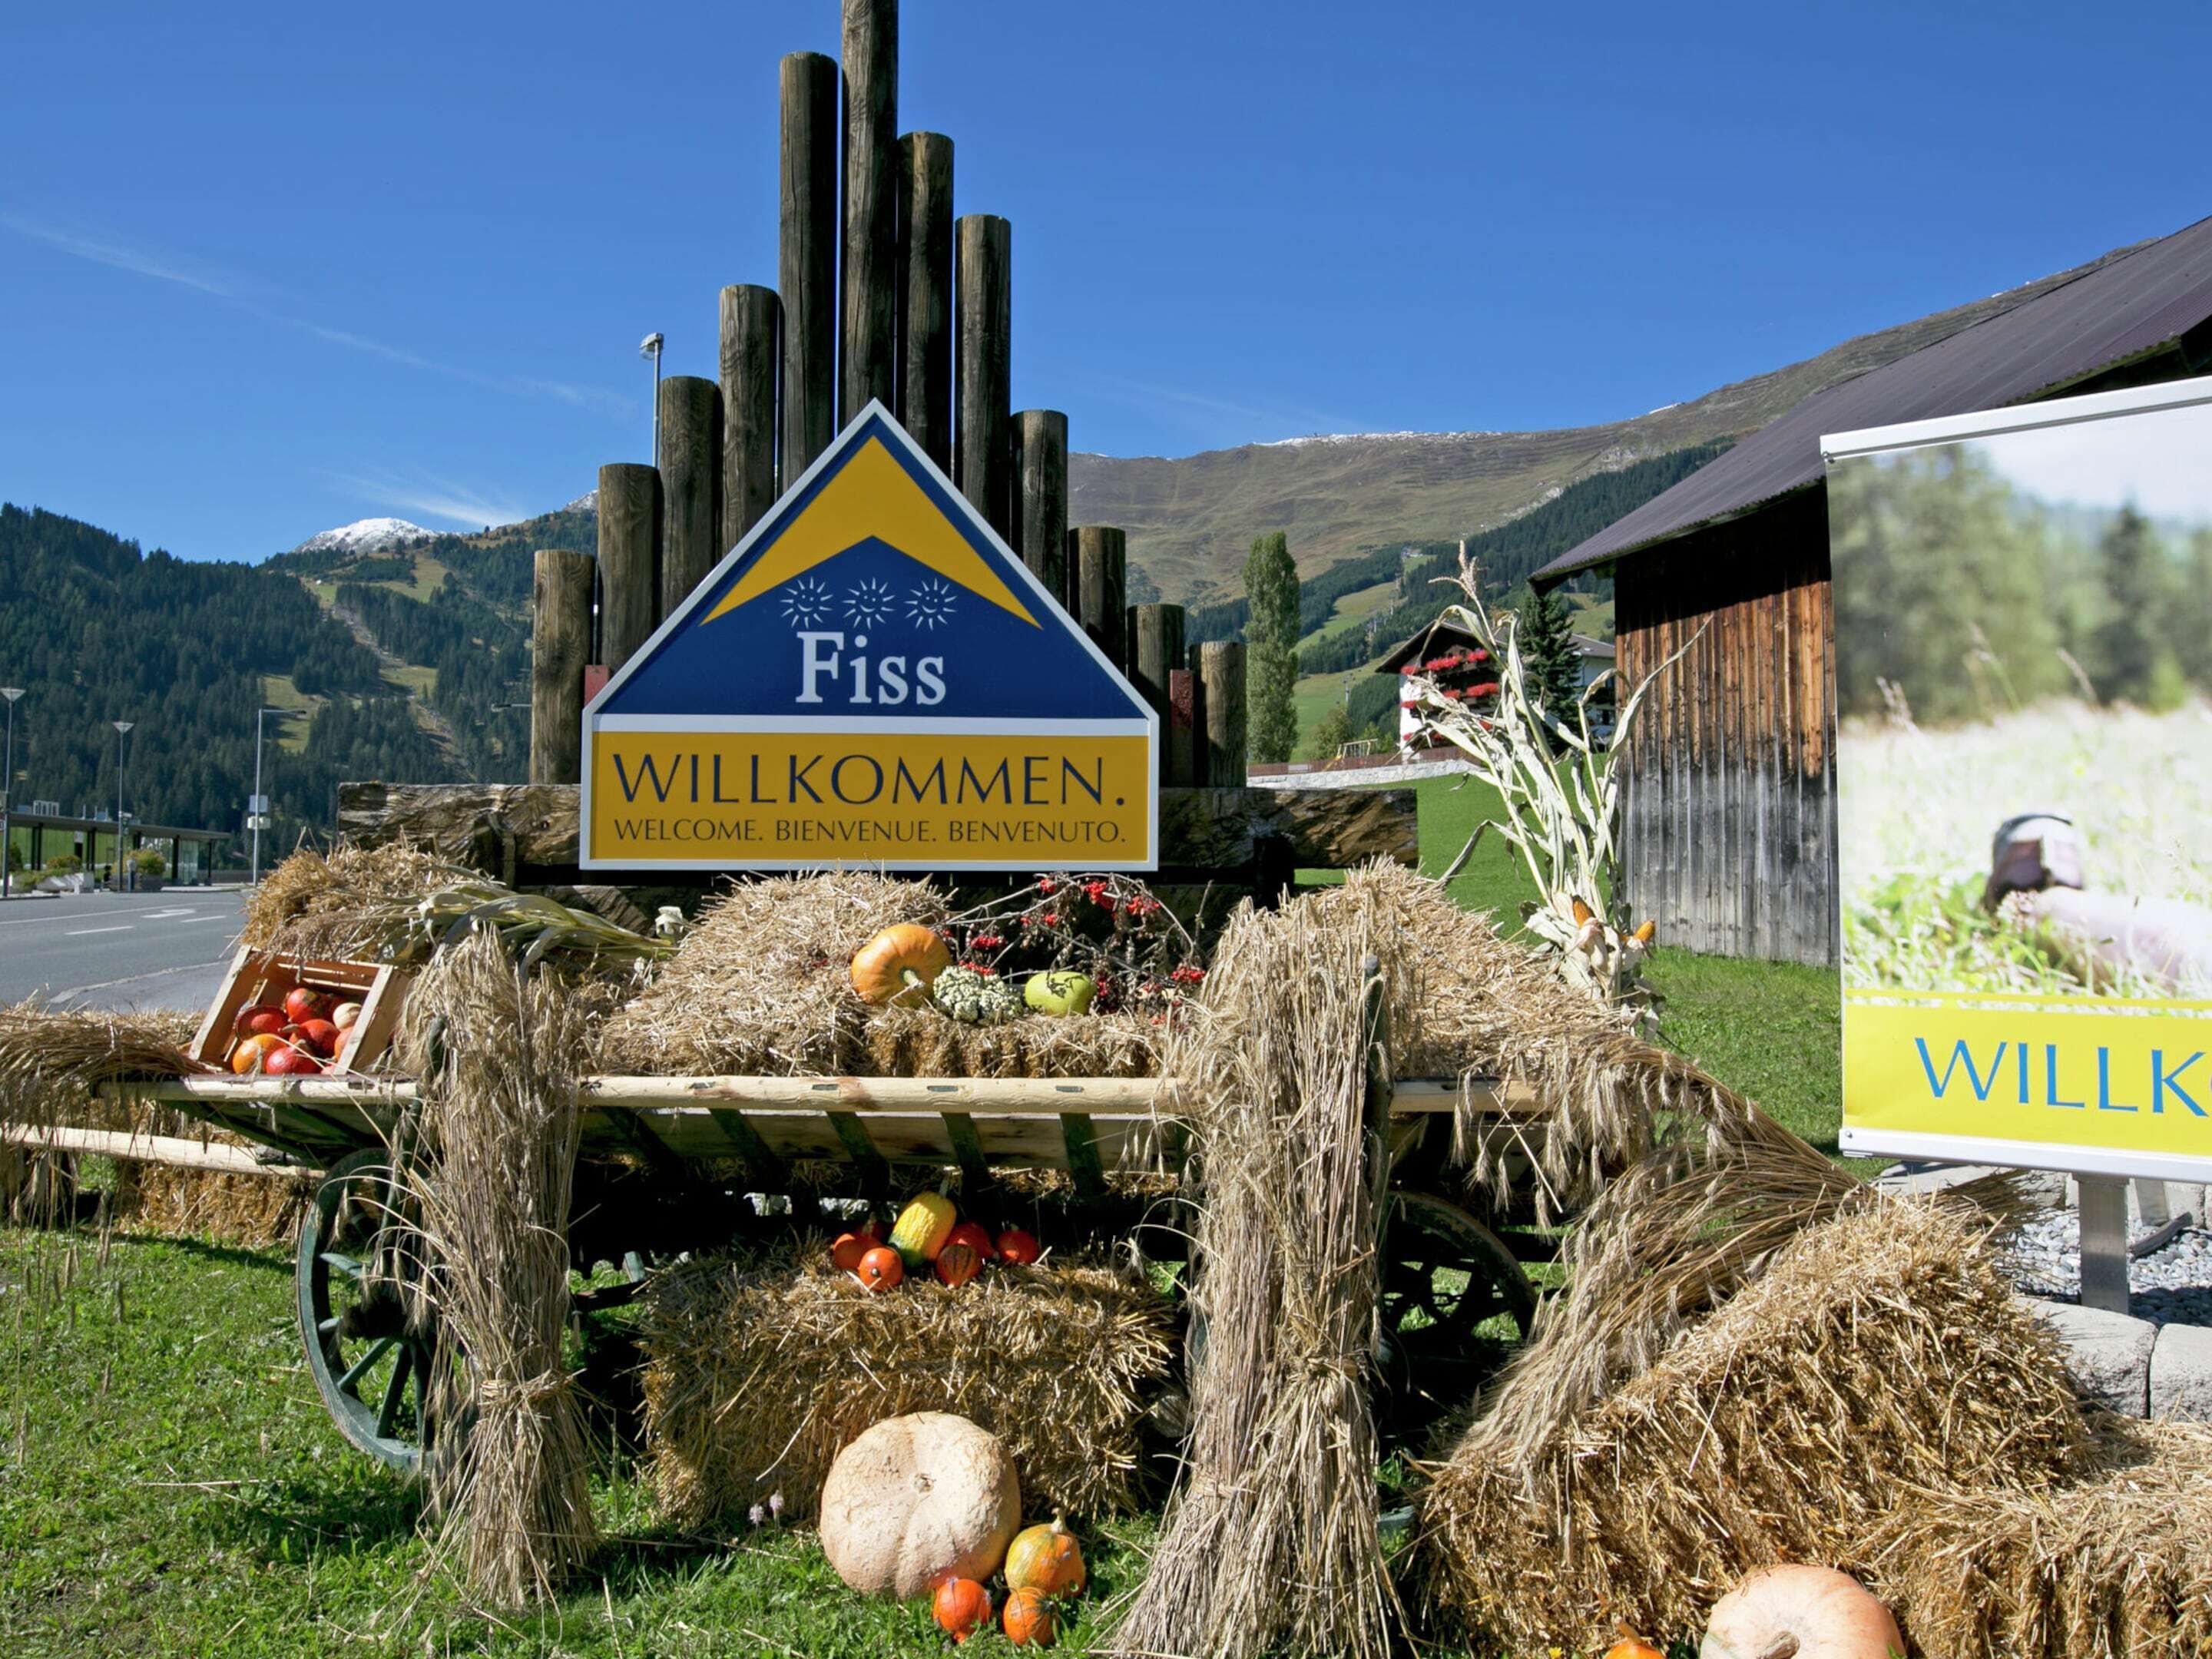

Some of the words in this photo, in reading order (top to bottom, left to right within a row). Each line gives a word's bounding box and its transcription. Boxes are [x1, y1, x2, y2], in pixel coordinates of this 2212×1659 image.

[795, 631, 947, 707] Fiss
[613, 753, 1125, 806] WILLKOMMEN.
[614, 818, 763, 841] WELCOME.
[776, 819, 937, 843] BIENVENUE.
[949, 820, 1126, 843] BENVENUTO.
[1914, 1037, 2212, 1118] WILLK
